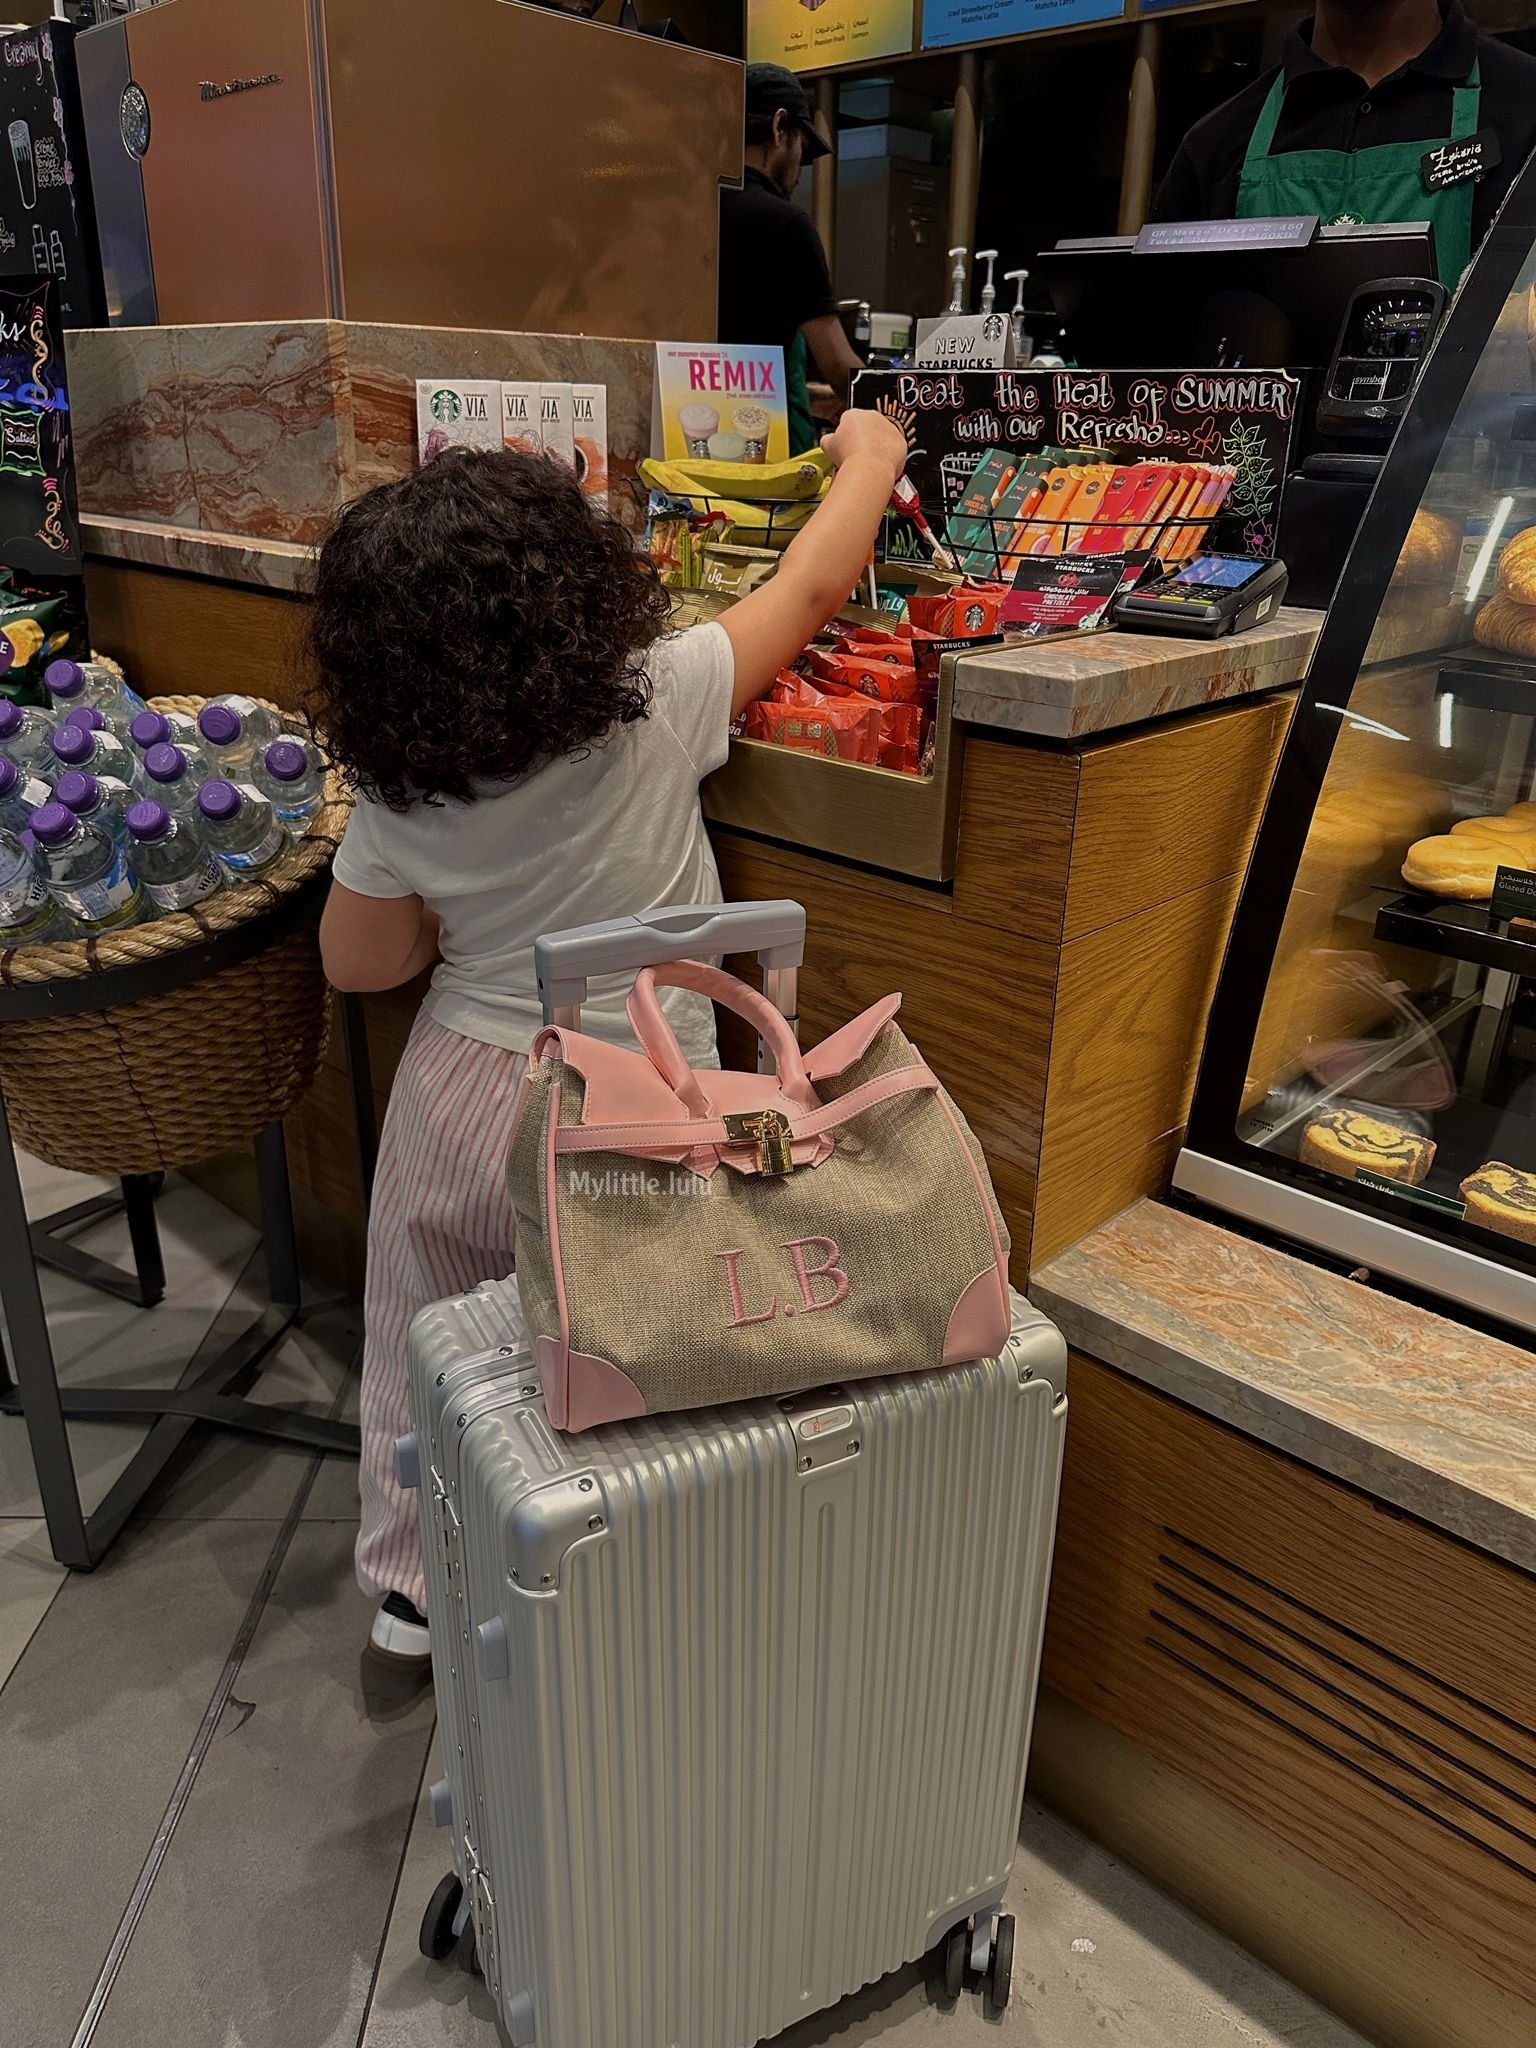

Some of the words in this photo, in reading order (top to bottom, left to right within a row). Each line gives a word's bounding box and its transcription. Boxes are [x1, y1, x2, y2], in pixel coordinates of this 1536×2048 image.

[935, 336, 975, 354] NEW
[918, 358, 993, 368] STARBUCKS
[689, 359, 775, 392] REMIX
[899, 375, 963, 407] Beat
[996, 374, 1037, 409] the
[1056, 375, 1111, 407] Heat
[1175, 377, 1288, 418] SUMMER
[466, 397, 486, 416] VIA
[507, 398, 526, 416] VIA
[573, 400, 592, 417] VIA
[957, 411, 999, 440] with
[1008, 417, 1042, 436] our
[6, 427, 37, 444] Salted
[708, 568, 743, 585] فول
[1054, 564, 1095, 574] STARBUCKS
[1043, 593, 1076, 601] CHOCOLATE
[933, 641, 970, 650] STARBUCKS
[1499, 881, 1526, 893] Glazed
